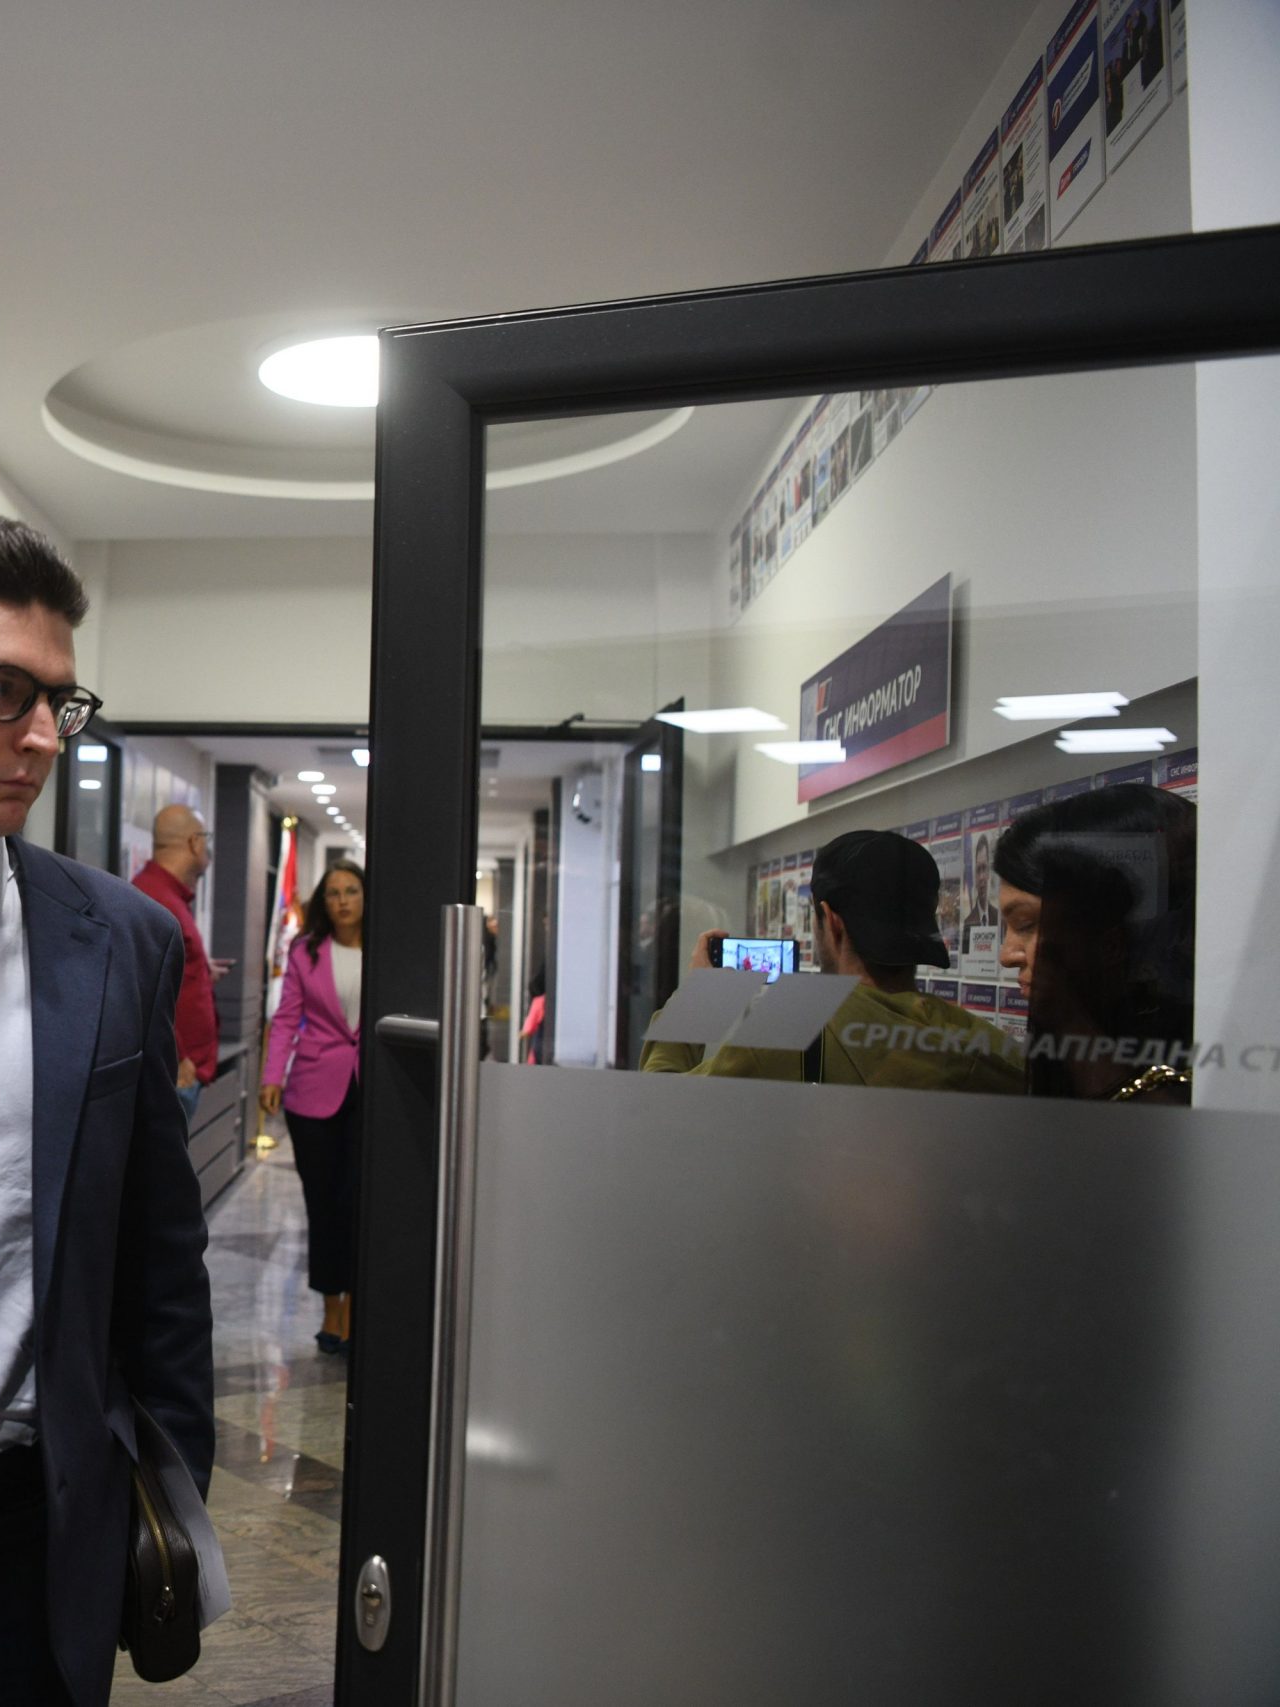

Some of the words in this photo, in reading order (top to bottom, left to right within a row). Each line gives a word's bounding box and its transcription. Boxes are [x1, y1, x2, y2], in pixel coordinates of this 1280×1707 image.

[844, 664, 922, 740] ИНФОРМАТОР
[839, 1021, 993, 1057] СРПСКА
[999, 1030, 1228, 1071] НАПРЕДНА
